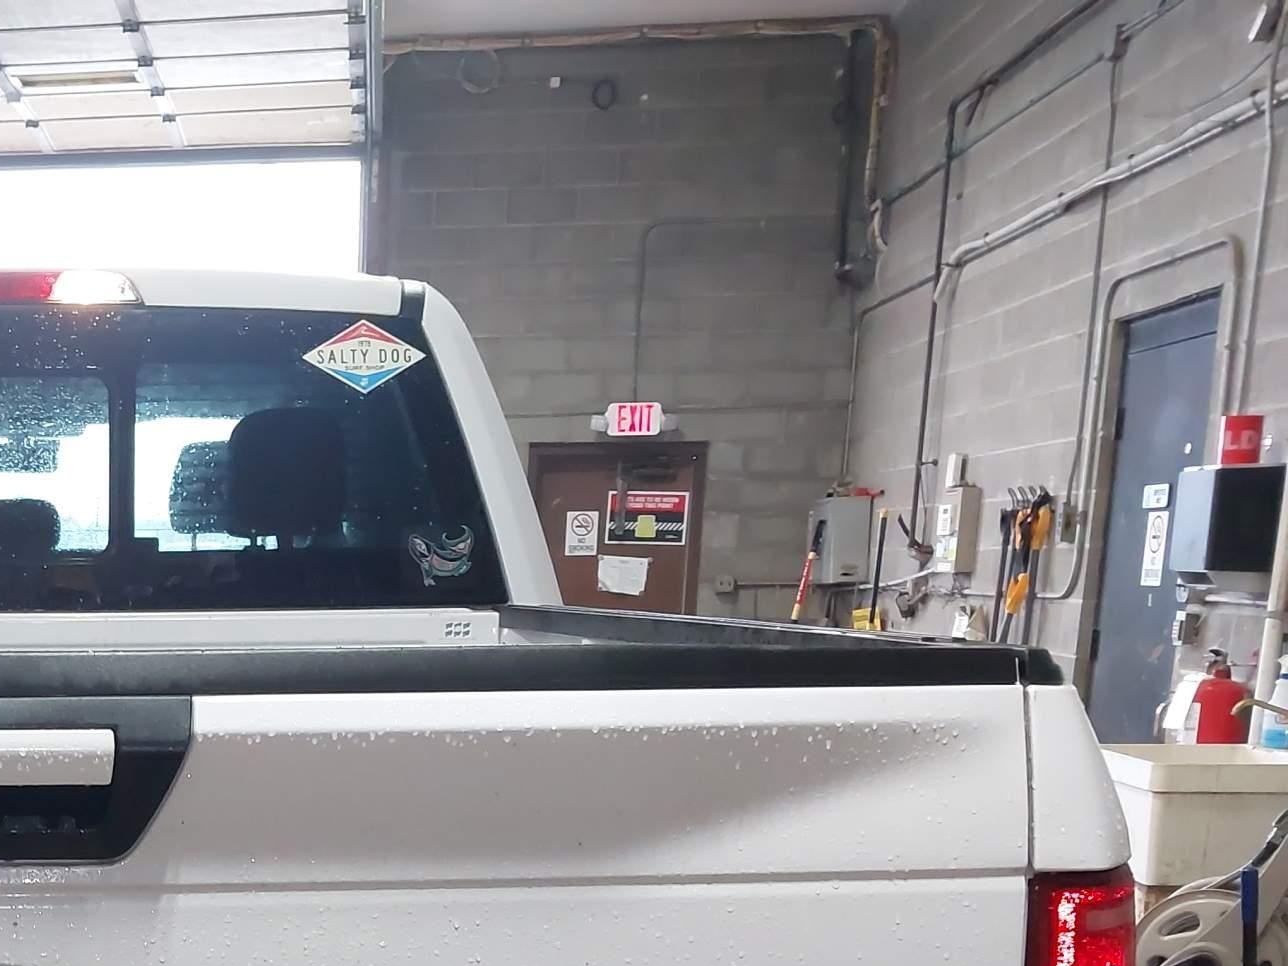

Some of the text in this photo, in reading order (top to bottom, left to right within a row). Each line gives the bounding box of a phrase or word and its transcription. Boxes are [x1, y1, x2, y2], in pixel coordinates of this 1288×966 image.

[316, 348, 412, 365] SALTY DOG
[617, 405, 655, 433] EXIT
